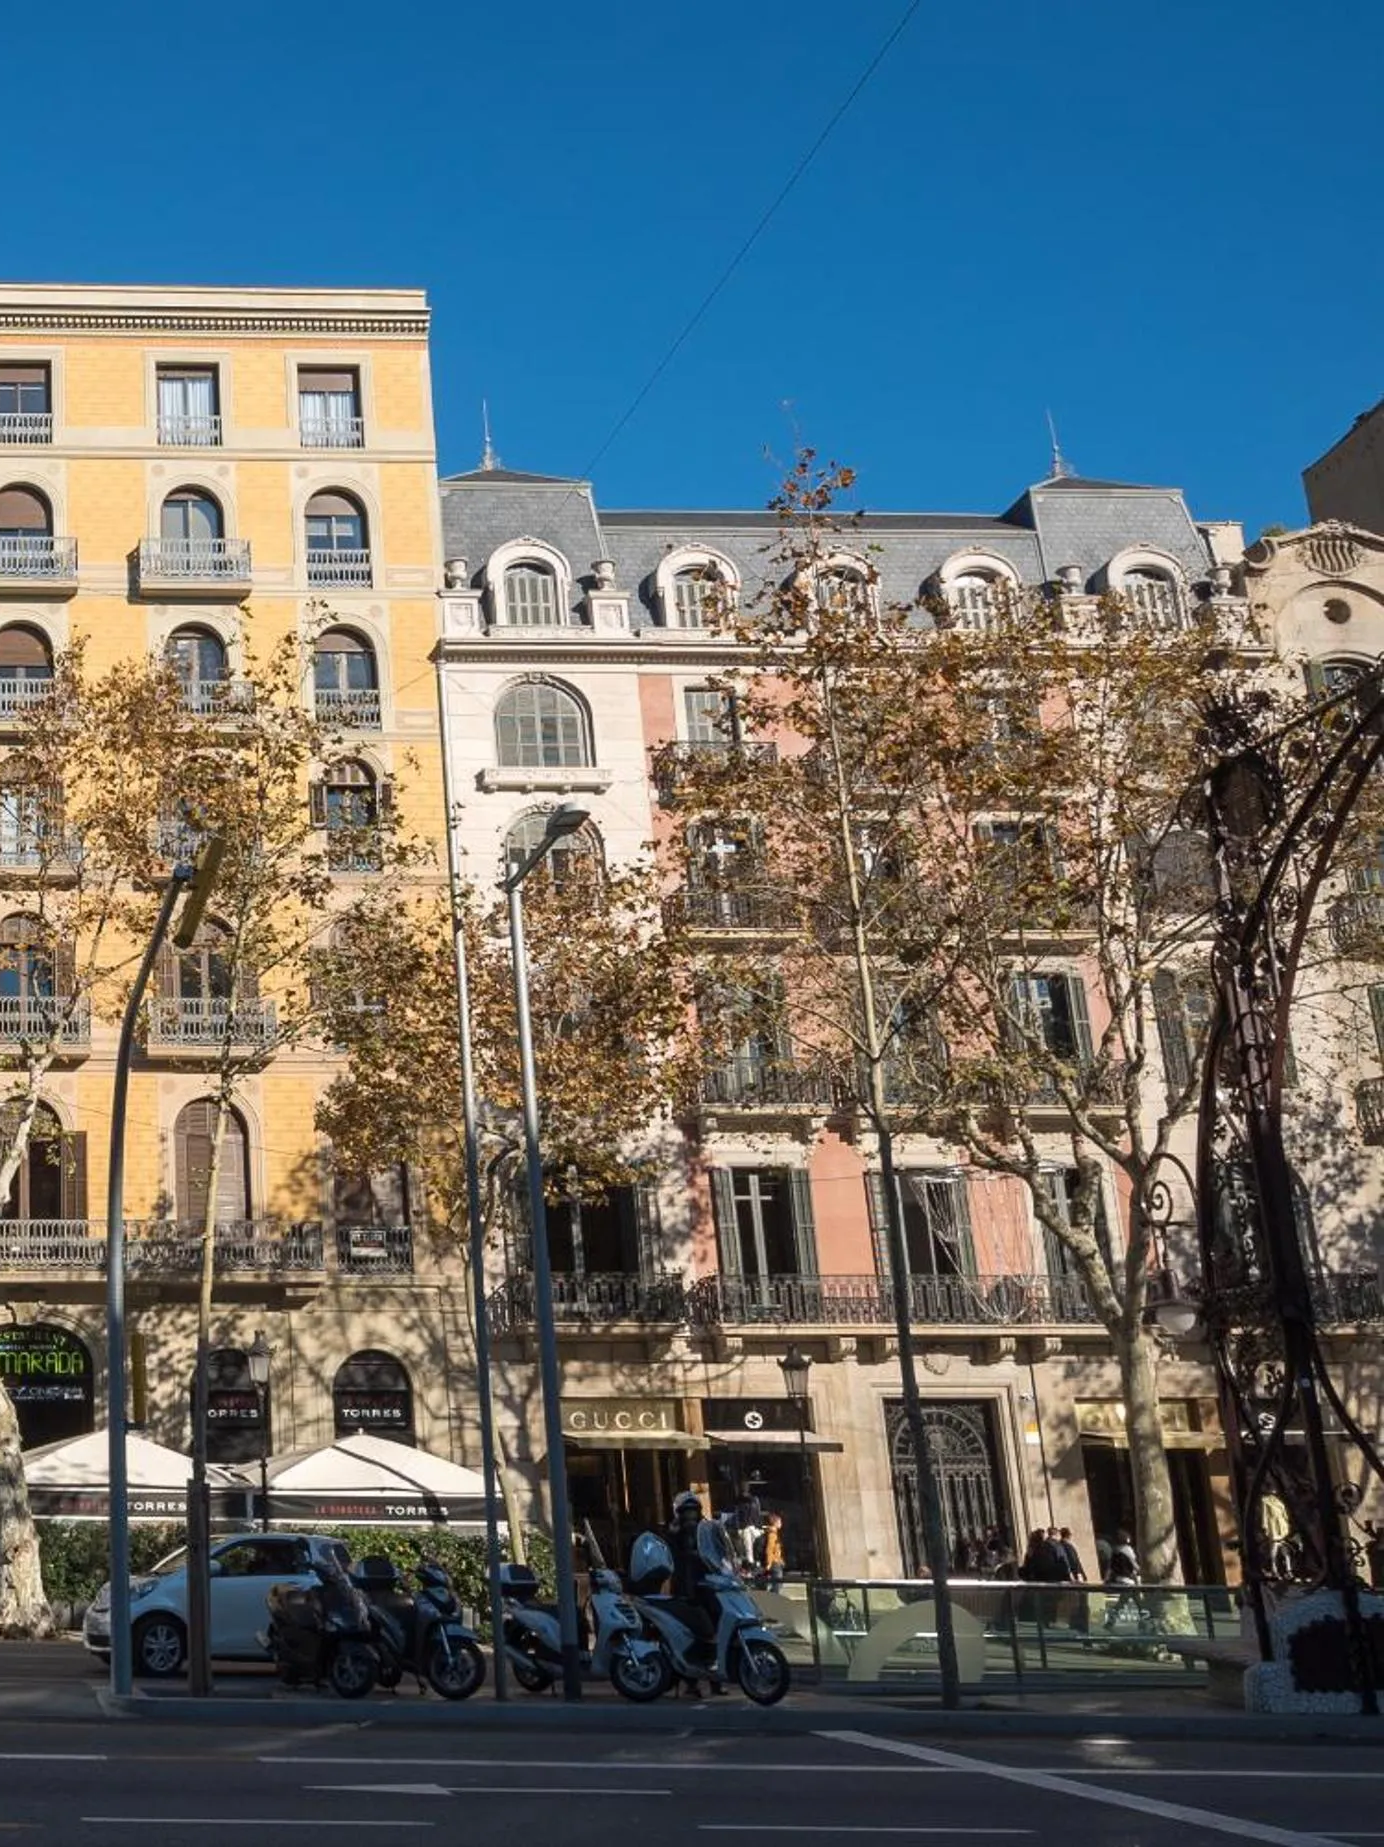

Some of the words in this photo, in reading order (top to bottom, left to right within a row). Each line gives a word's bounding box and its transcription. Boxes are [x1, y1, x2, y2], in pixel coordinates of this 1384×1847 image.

[207, 1408, 259, 1418] ORRES
[343, 1408, 402, 1418] TORRES
[569, 1411, 668, 1429] GUCCI
